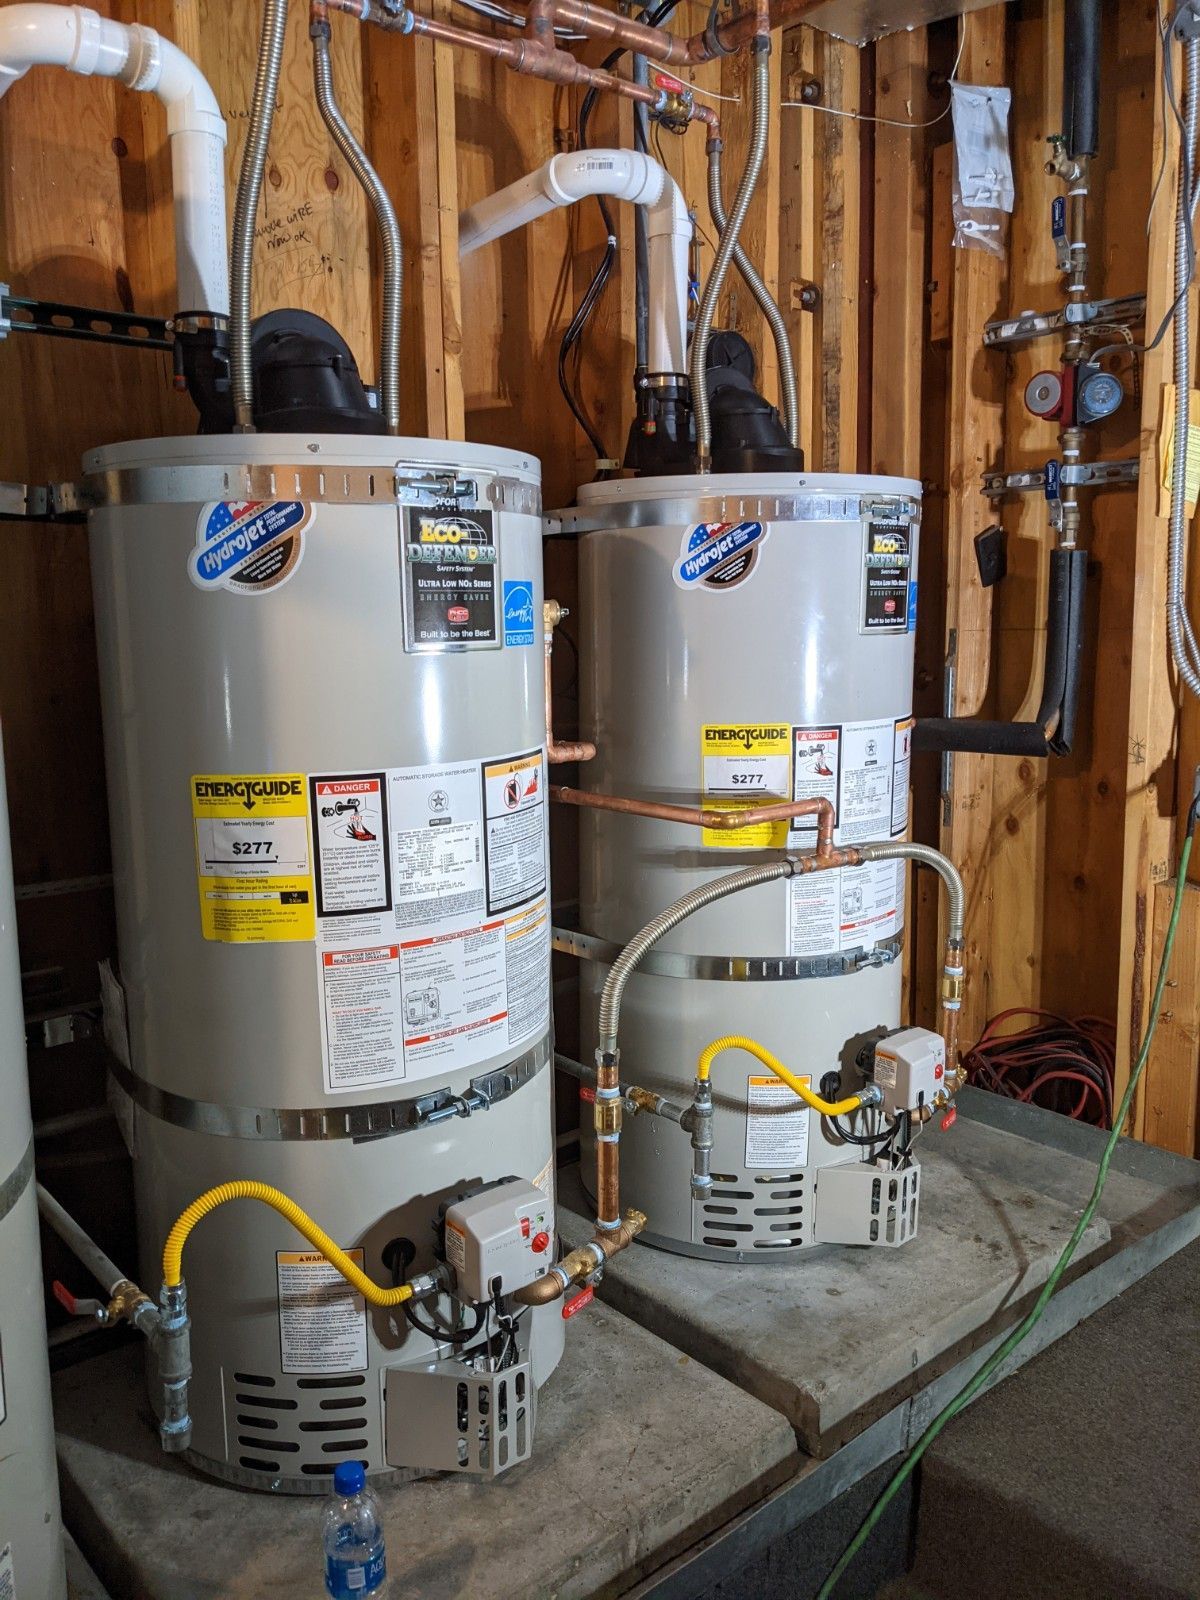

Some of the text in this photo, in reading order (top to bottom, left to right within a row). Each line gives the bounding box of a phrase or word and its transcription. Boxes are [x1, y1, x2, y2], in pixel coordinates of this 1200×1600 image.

[263, 509, 277, 521] TOTAL
[268, 518, 286, 533] SYSTEM
[203, 518, 267, 573] Hydrojet
[407, 543, 497, 563] DEFENDER
[685, 534, 734, 576] Hydrojet
[418, 579, 440, 588] ULTRA
[473, 580, 492, 588] SERIES
[420, 630, 439, 639] Built
[450, 630, 460, 638] be
[461, 630, 473, 638] the
[474, 629, 491, 637] Best
[705, 728, 788, 740] ENERGYGUIDE
[808, 732, 833, 740] DANGER
[732, 774, 763, 784] $277
[195, 780, 302, 797] ENERGYGUIDE
[334, 783, 370, 792] DANGER
[232, 841, 273, 856] $277
